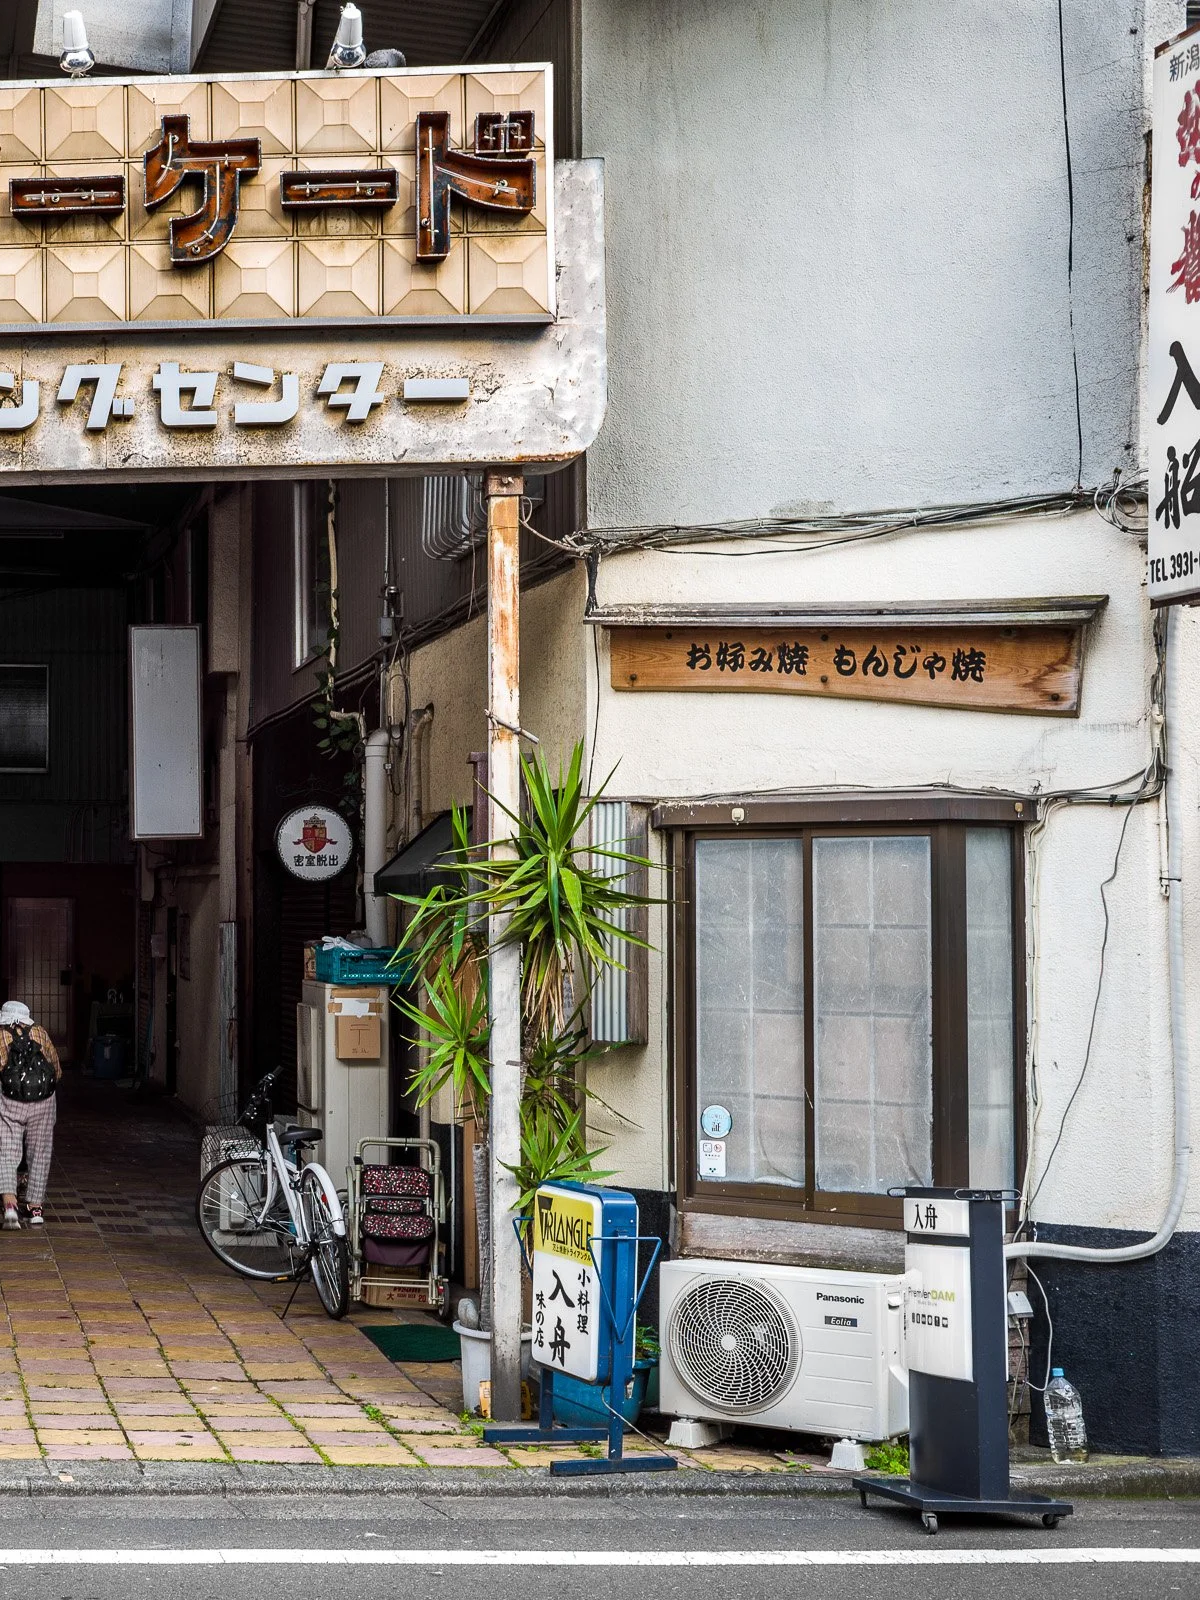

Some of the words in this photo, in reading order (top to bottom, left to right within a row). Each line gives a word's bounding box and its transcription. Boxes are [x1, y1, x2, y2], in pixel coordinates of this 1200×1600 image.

[1150, 557, 1168, 584] TEL
[1170, 550, 1200, 580] 3931-
[686, 642, 808, 676] お好み焼
[833, 645, 987, 683] もんじゃ焼
[293, 854, 339, 867] 密室脱出
[538, 1195, 592, 1252] TRIANGLE
[913, 1203, 939, 1231] 入舟
[576, 1268, 591, 1336] 小料理
[816, 1292, 865, 1305] Panasonic
[534, 1290, 547, 1349] 味の店
[548, 1269, 575, 1368] 入舟
[830, 1317, 852, 1326] Eolia
